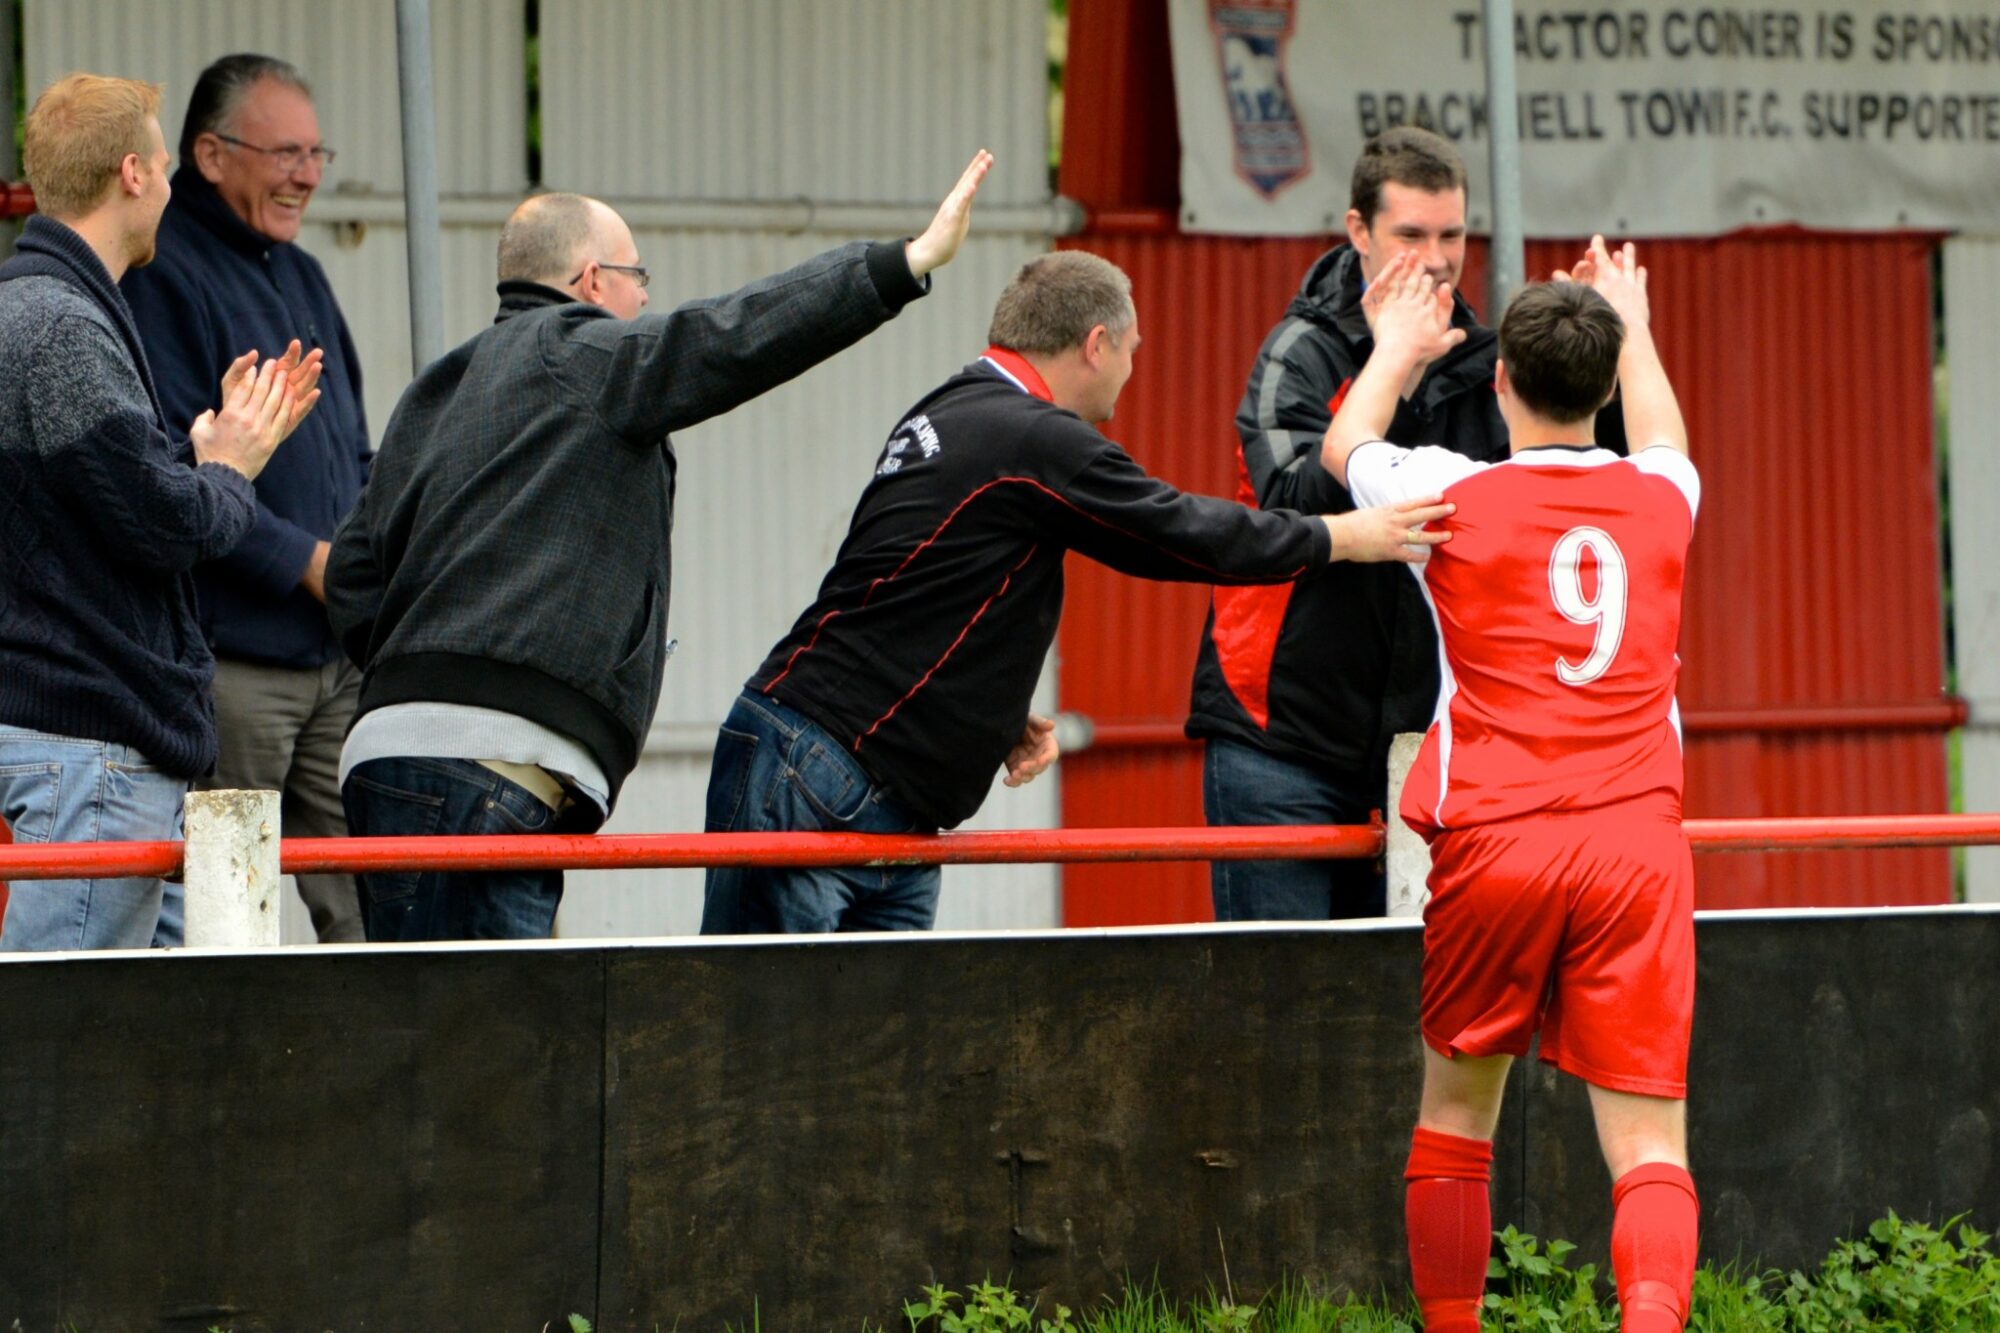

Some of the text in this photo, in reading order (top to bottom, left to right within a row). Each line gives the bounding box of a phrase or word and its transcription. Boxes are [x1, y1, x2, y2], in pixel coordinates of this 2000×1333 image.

[1454, 12, 1648, 59] TACTOR
[1817, 12, 1853, 60] IS
[1358, 92, 1603, 139] BRACKELL
[1735, 90, 1793, 137] F.C.
[1548, 526, 1628, 686] 9
